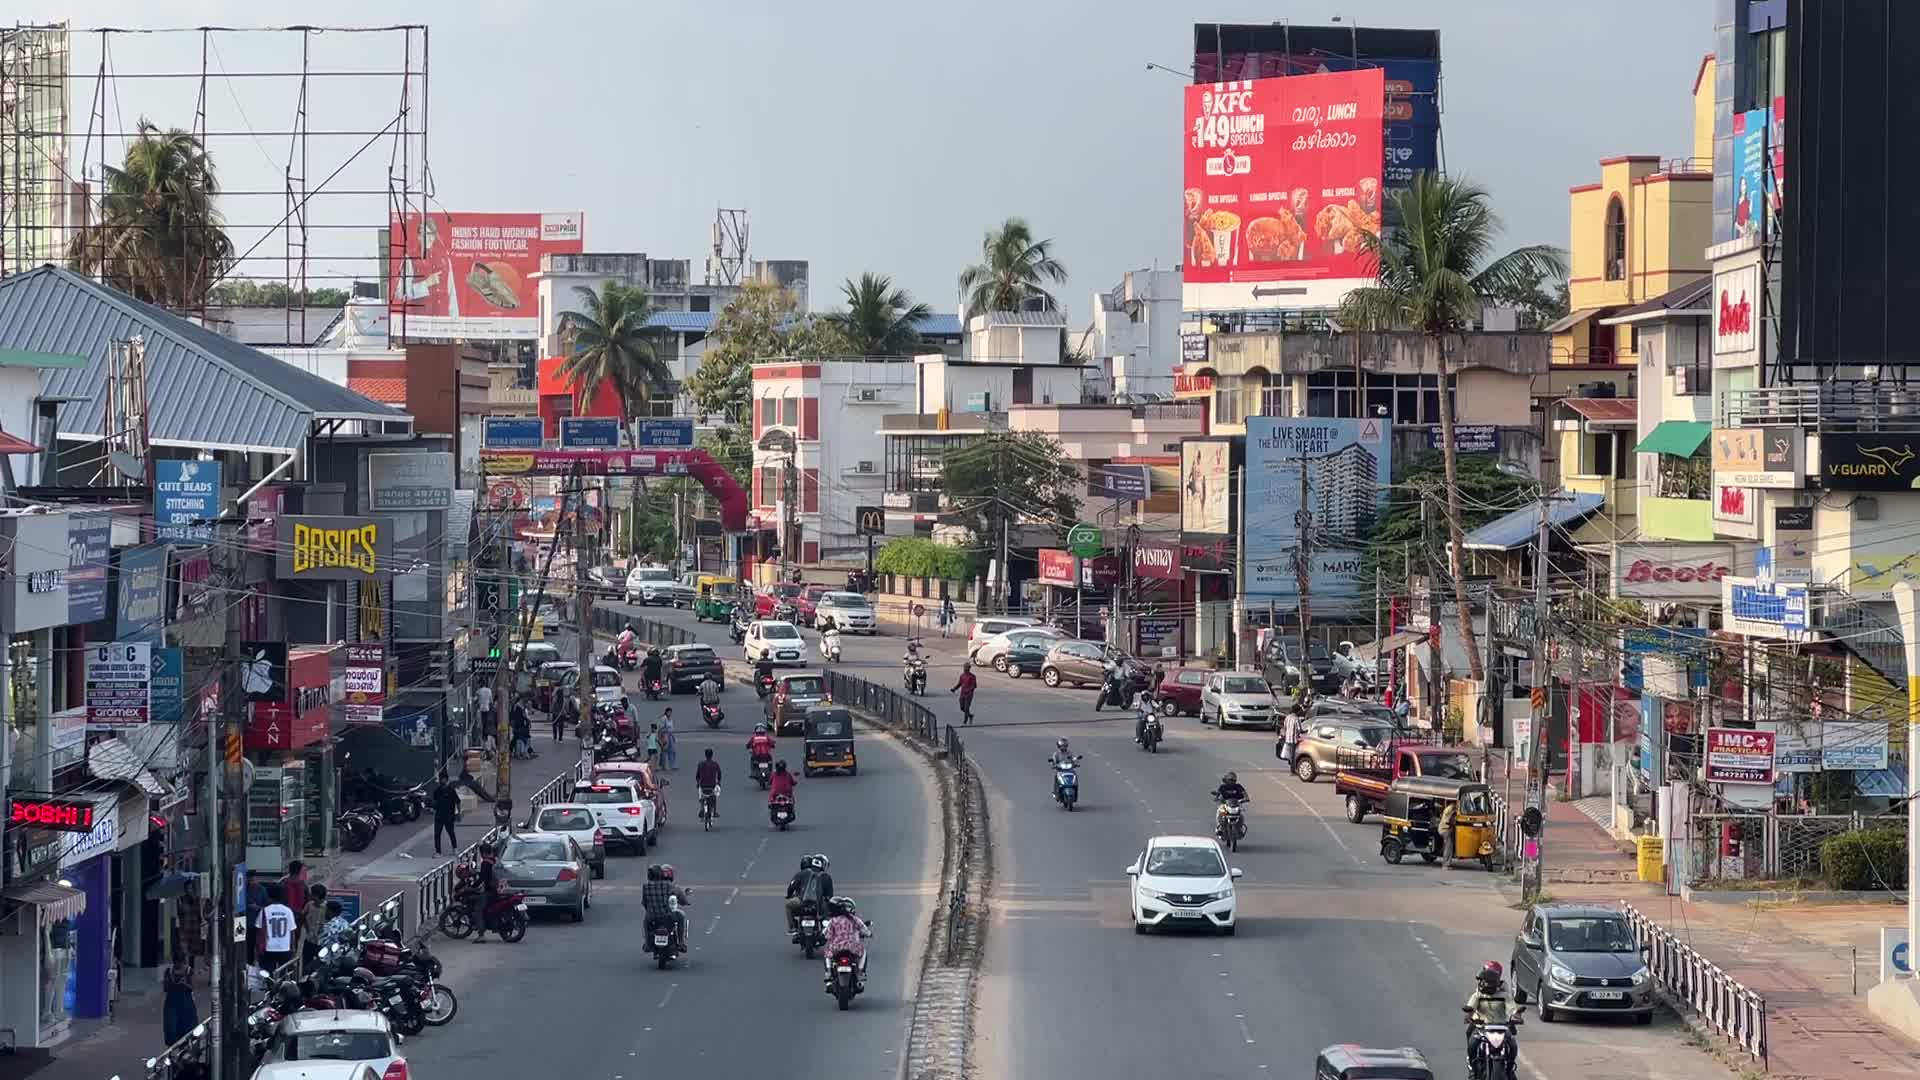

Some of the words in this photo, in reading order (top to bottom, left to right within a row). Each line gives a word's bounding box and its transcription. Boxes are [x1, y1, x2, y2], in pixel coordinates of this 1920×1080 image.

[1213, 91, 1253, 114] KFC
[1327, 102, 1357, 121] LUNCH
[1230, 114, 1265, 133] LUNCH
[1230, 131, 1265, 146] SPECIALS
[480, 227, 500, 238] HARD
[502, 227, 538, 238] WORKING
[452, 239, 482, 250] FASHION
[1272, 427, 1293, 440] LIVE
[1295, 427, 1328, 440] SMART
[1258, 439, 1271, 449] THE
[1296, 440, 1328, 453] HEART
[158, 482, 181, 491] CUTE
[294, 523, 376, 574] BASICS
[95, 708, 140, 717] aramex
[1717, 734, 1753, 747] IMC
[269, 917, 288, 938] 10
